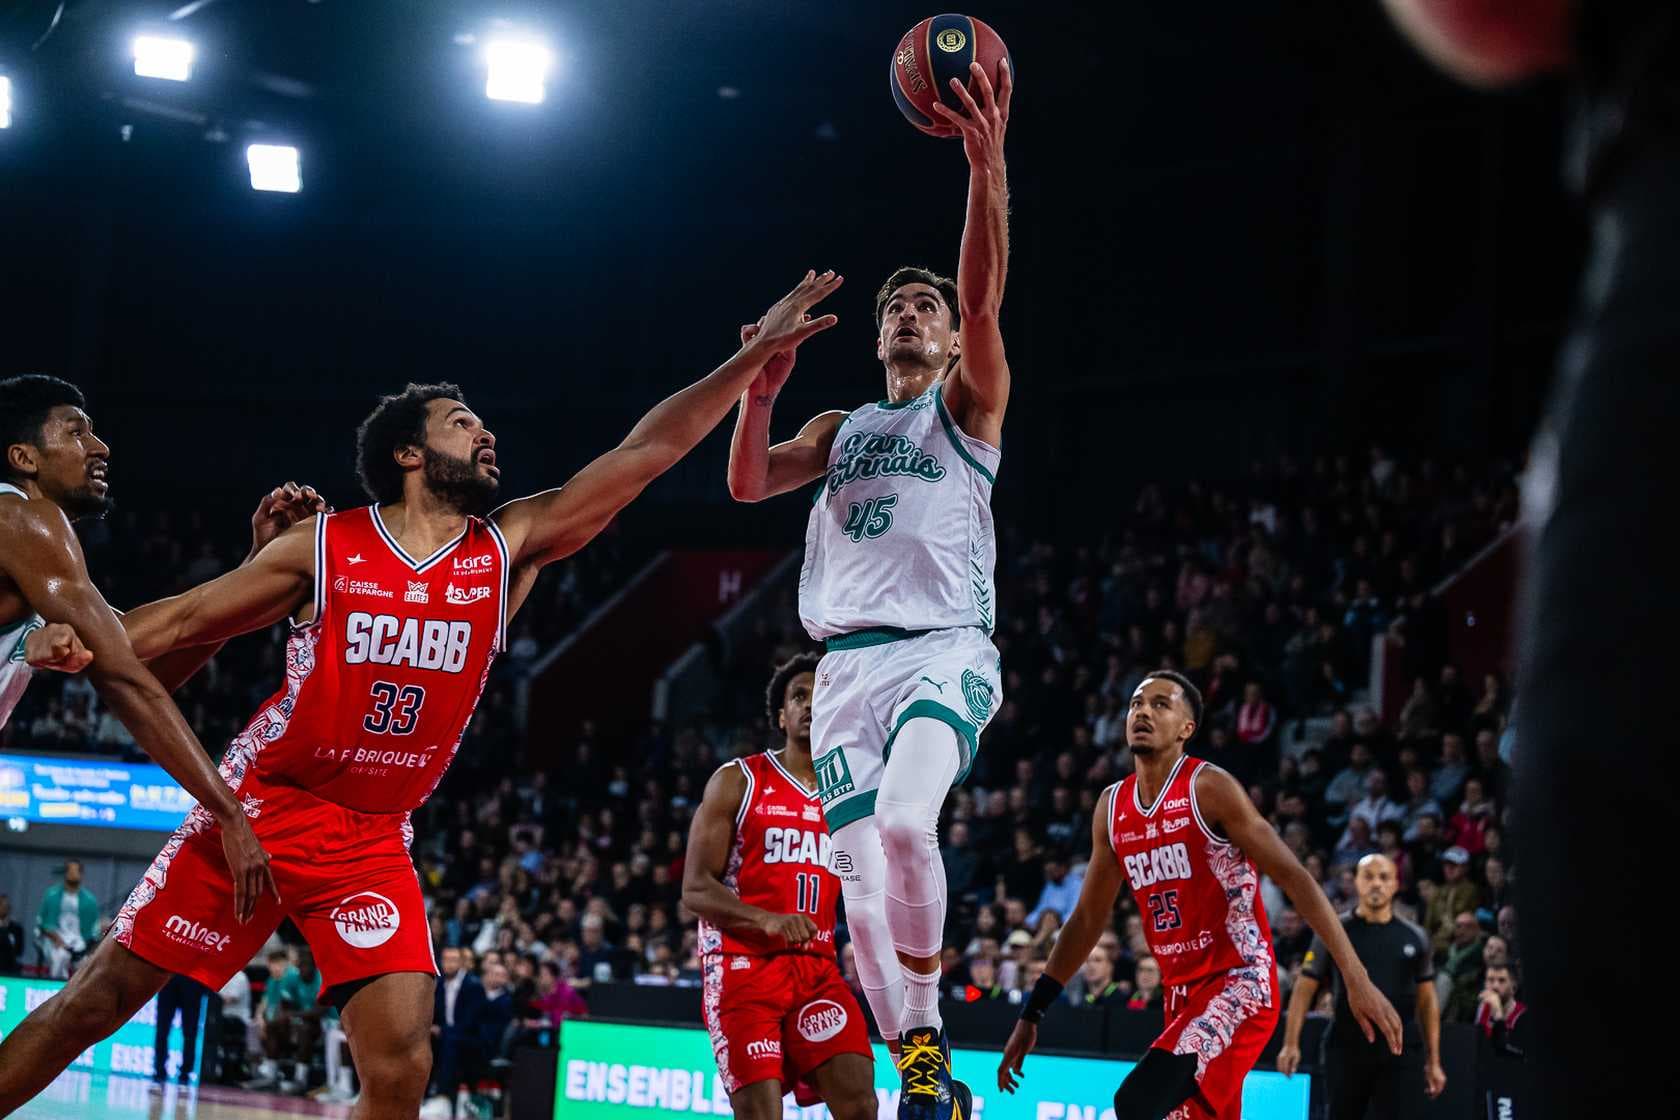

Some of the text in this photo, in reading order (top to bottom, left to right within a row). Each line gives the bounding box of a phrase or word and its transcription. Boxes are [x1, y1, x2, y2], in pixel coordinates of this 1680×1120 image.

[843, 493, 898, 542] 45
[349, 587, 394, 598] D'EPARGNE
[350, 580, 379, 589] CAISSE
[454, 586, 491, 600] SUPER
[345, 611, 472, 674] SCABB
[363, 680, 426, 736] 33
[314, 747, 335, 760] LA
[340, 747, 419, 768] FBRIQUE
[833, 782, 853, 797] BTP
[763, 827, 833, 869] SCAB
[1123, 842, 1192, 891] SCABB
[796, 871, 820, 915] 11
[338, 902, 388, 923] GRAND
[1147, 888, 1183, 933] 25
[164, 914, 231, 952] minet
[343, 913, 392, 934] FRAIS
[803, 1007, 840, 1028] GRAND
[804, 1015, 841, 1037] FRAIS
